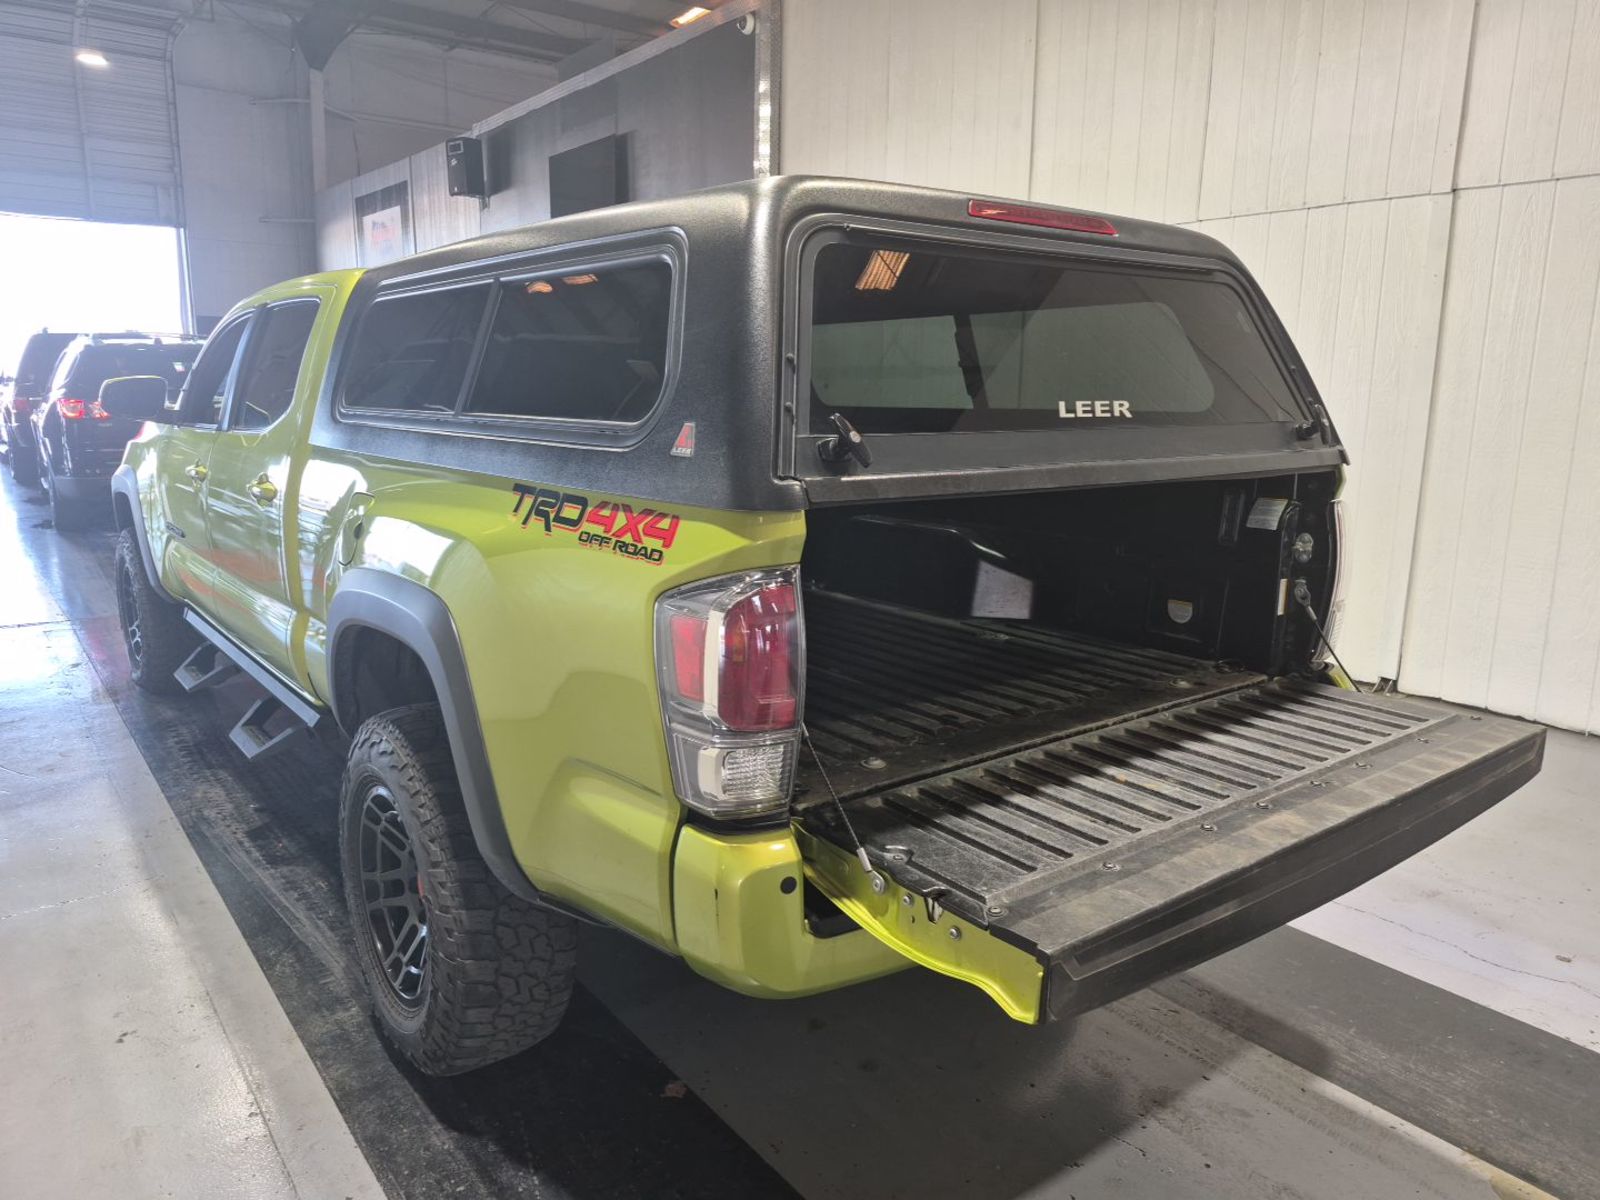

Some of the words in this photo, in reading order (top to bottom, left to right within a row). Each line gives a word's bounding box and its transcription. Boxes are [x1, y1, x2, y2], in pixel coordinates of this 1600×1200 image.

[1058, 400, 1133, 418] LEER
[512, 483, 589, 535] TRD
[578, 531, 613, 548] OFF
[612, 539, 664, 564] ROAD
